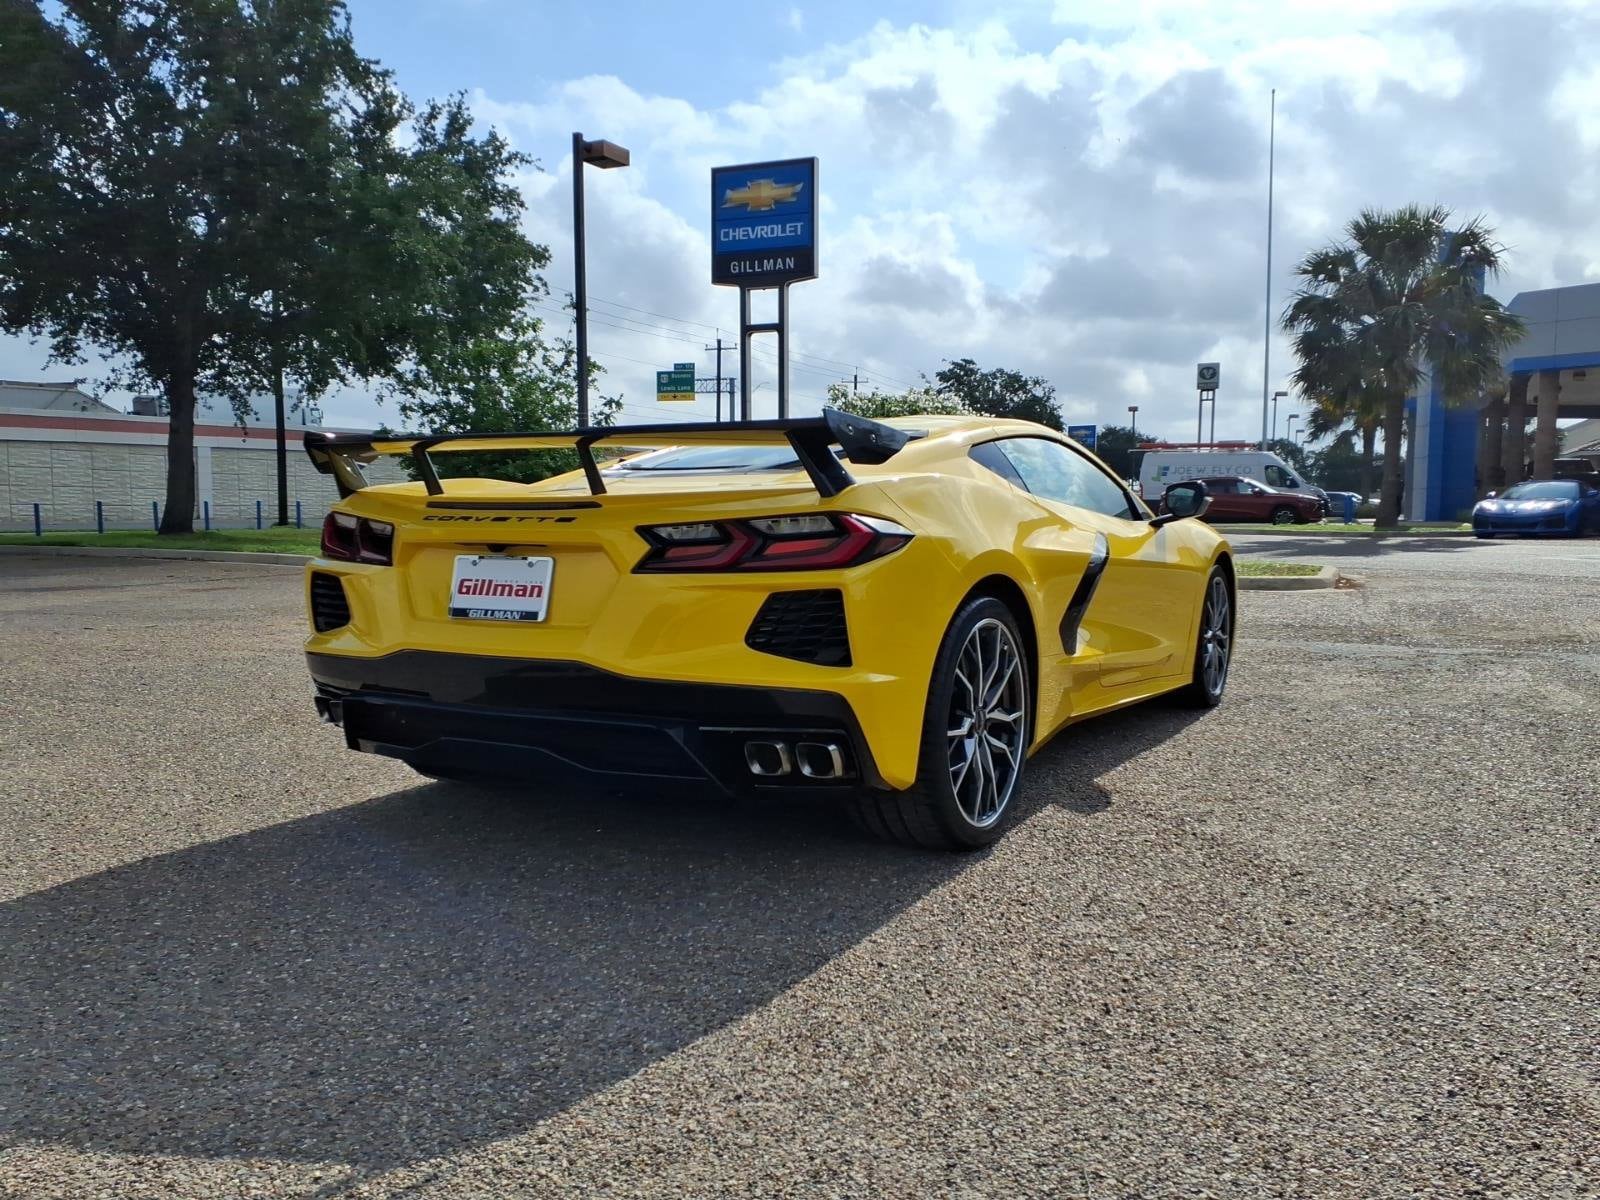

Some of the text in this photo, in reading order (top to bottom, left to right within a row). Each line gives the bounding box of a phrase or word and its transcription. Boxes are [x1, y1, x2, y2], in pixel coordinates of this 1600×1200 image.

[720, 222, 803, 241] CHEVROLET
[731, 257, 795, 273] GILLMAN
[1172, 465, 1192, 475] JOE
[1212, 465, 1233, 475] FLY
[422, 515, 578, 523] CORVETTE
[457, 578, 544, 598] Gillman
